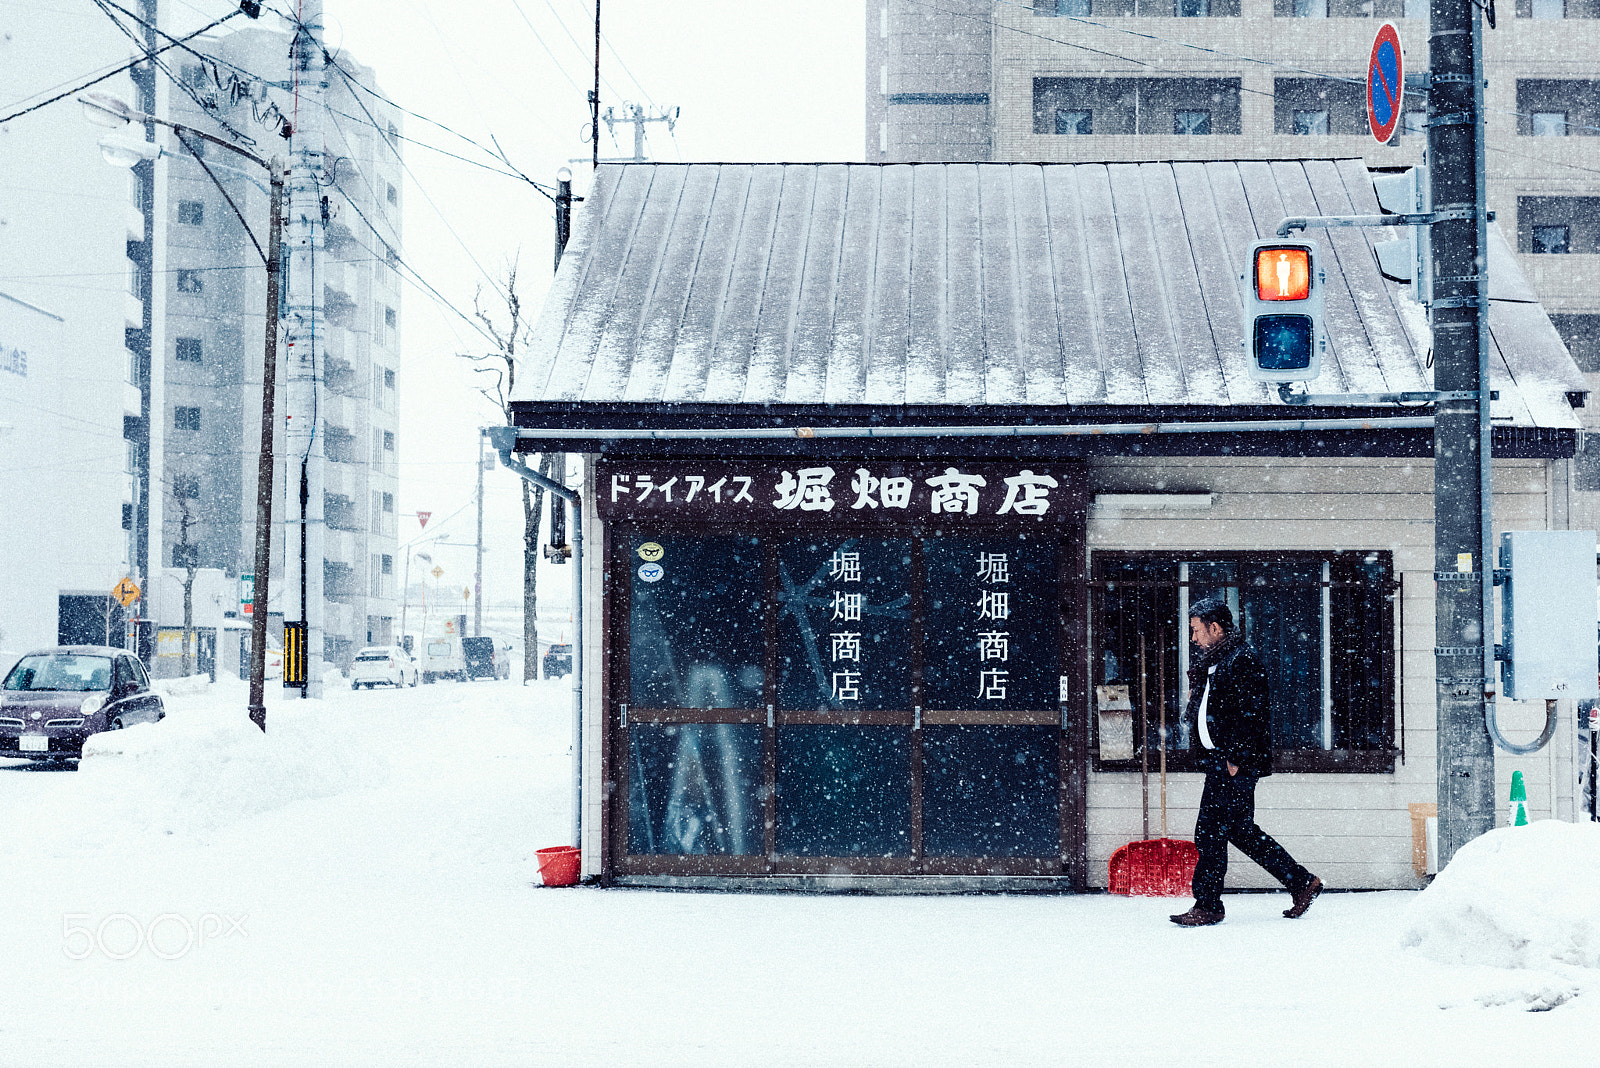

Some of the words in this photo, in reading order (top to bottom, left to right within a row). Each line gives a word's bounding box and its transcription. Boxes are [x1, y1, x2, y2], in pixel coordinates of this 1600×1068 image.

[610, 474, 755, 504] ドライアイス
[772, 466, 1059, 517] 堀畑商店
[829, 550, 863, 702] 堀畑商店
[976, 551, 1010, 699] 堀畑商店
